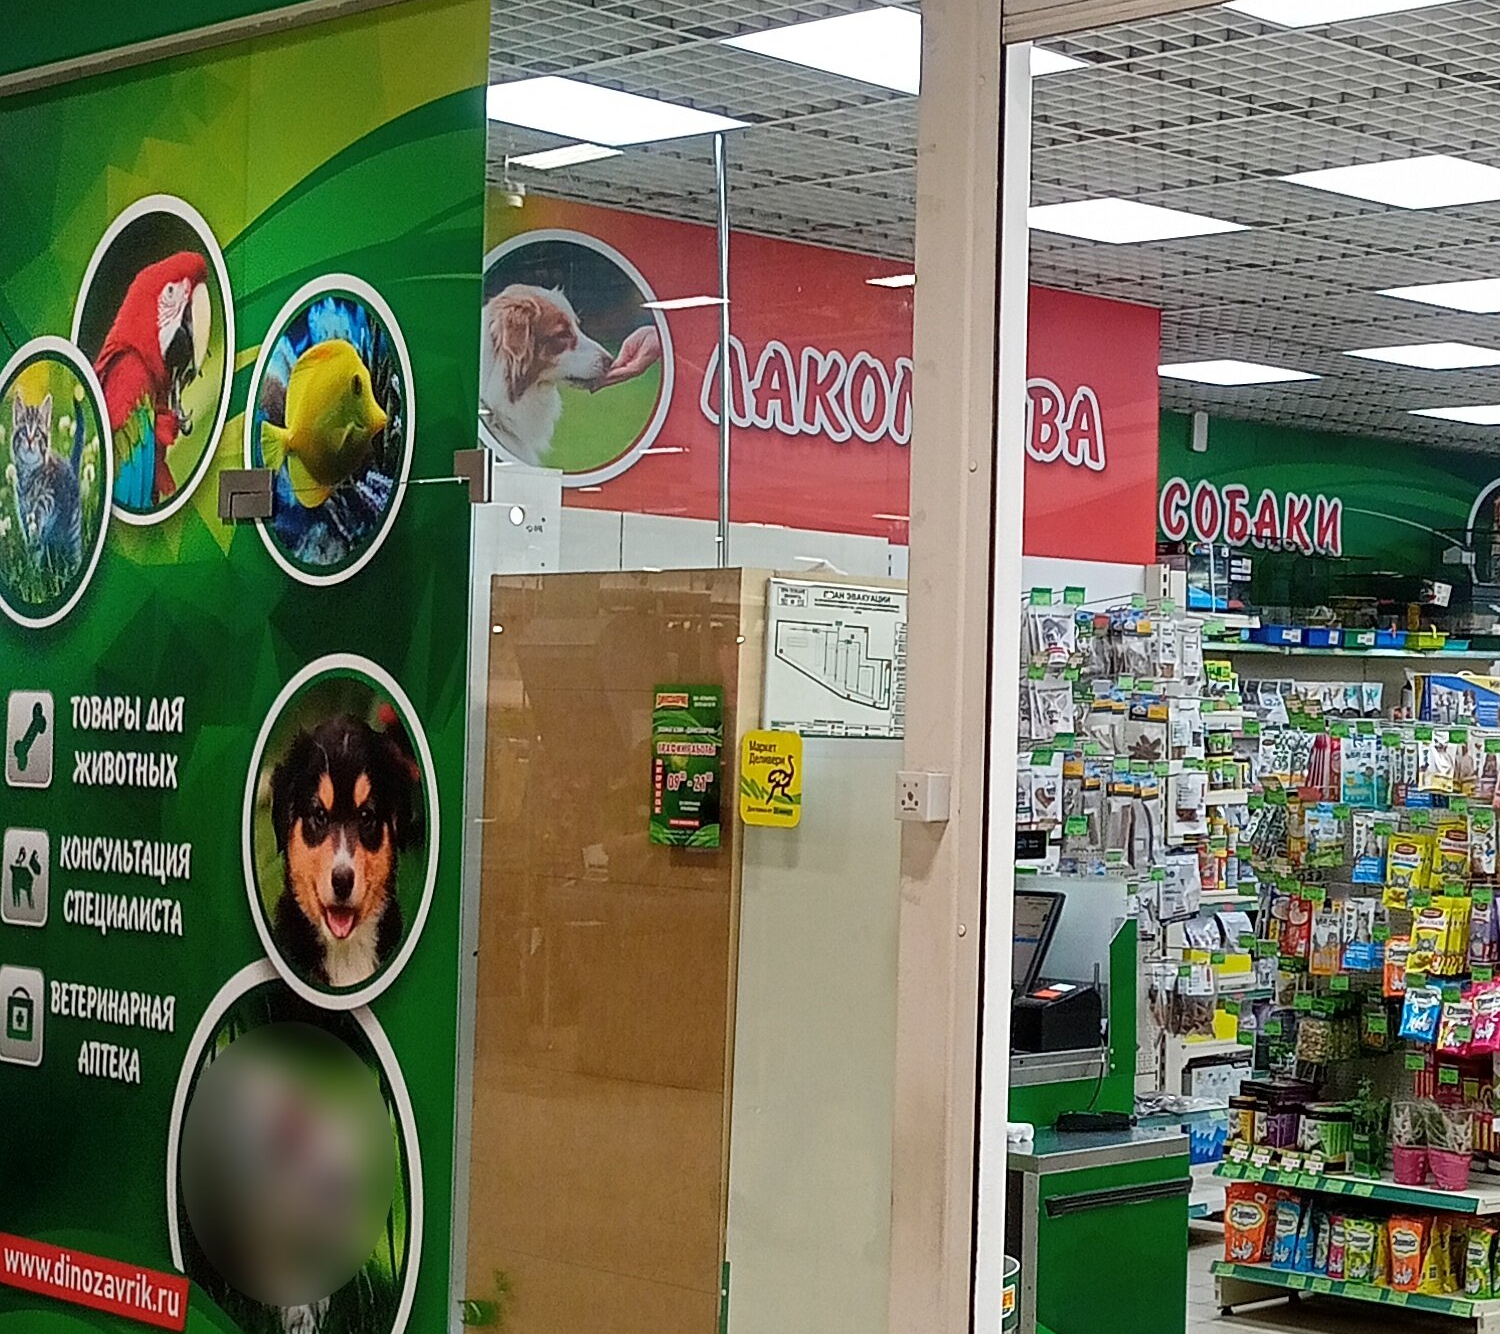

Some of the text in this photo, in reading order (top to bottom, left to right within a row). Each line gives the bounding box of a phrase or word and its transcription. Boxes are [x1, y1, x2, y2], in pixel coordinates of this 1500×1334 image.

[1161, 476, 1343, 557] СОБАКИ
[69, 694, 185, 734] ТОВАРЫ ДЛЯ
[72, 748, 179, 789] ЖИВОТНЫХ
[749, 741, 777, 755] Маркет
[59, 834, 192, 880] КОНСУЛЬТАЦИЯ
[62, 887, 183, 937] СПЕЦИАЛИСТА
[50, 980, 177, 1033] ВЕТЕРИНАРНАЯ
[77, 1044, 141, 1084] АПТЕКА
[2, 1243, 181, 1320] www.dinozavrik.ru
